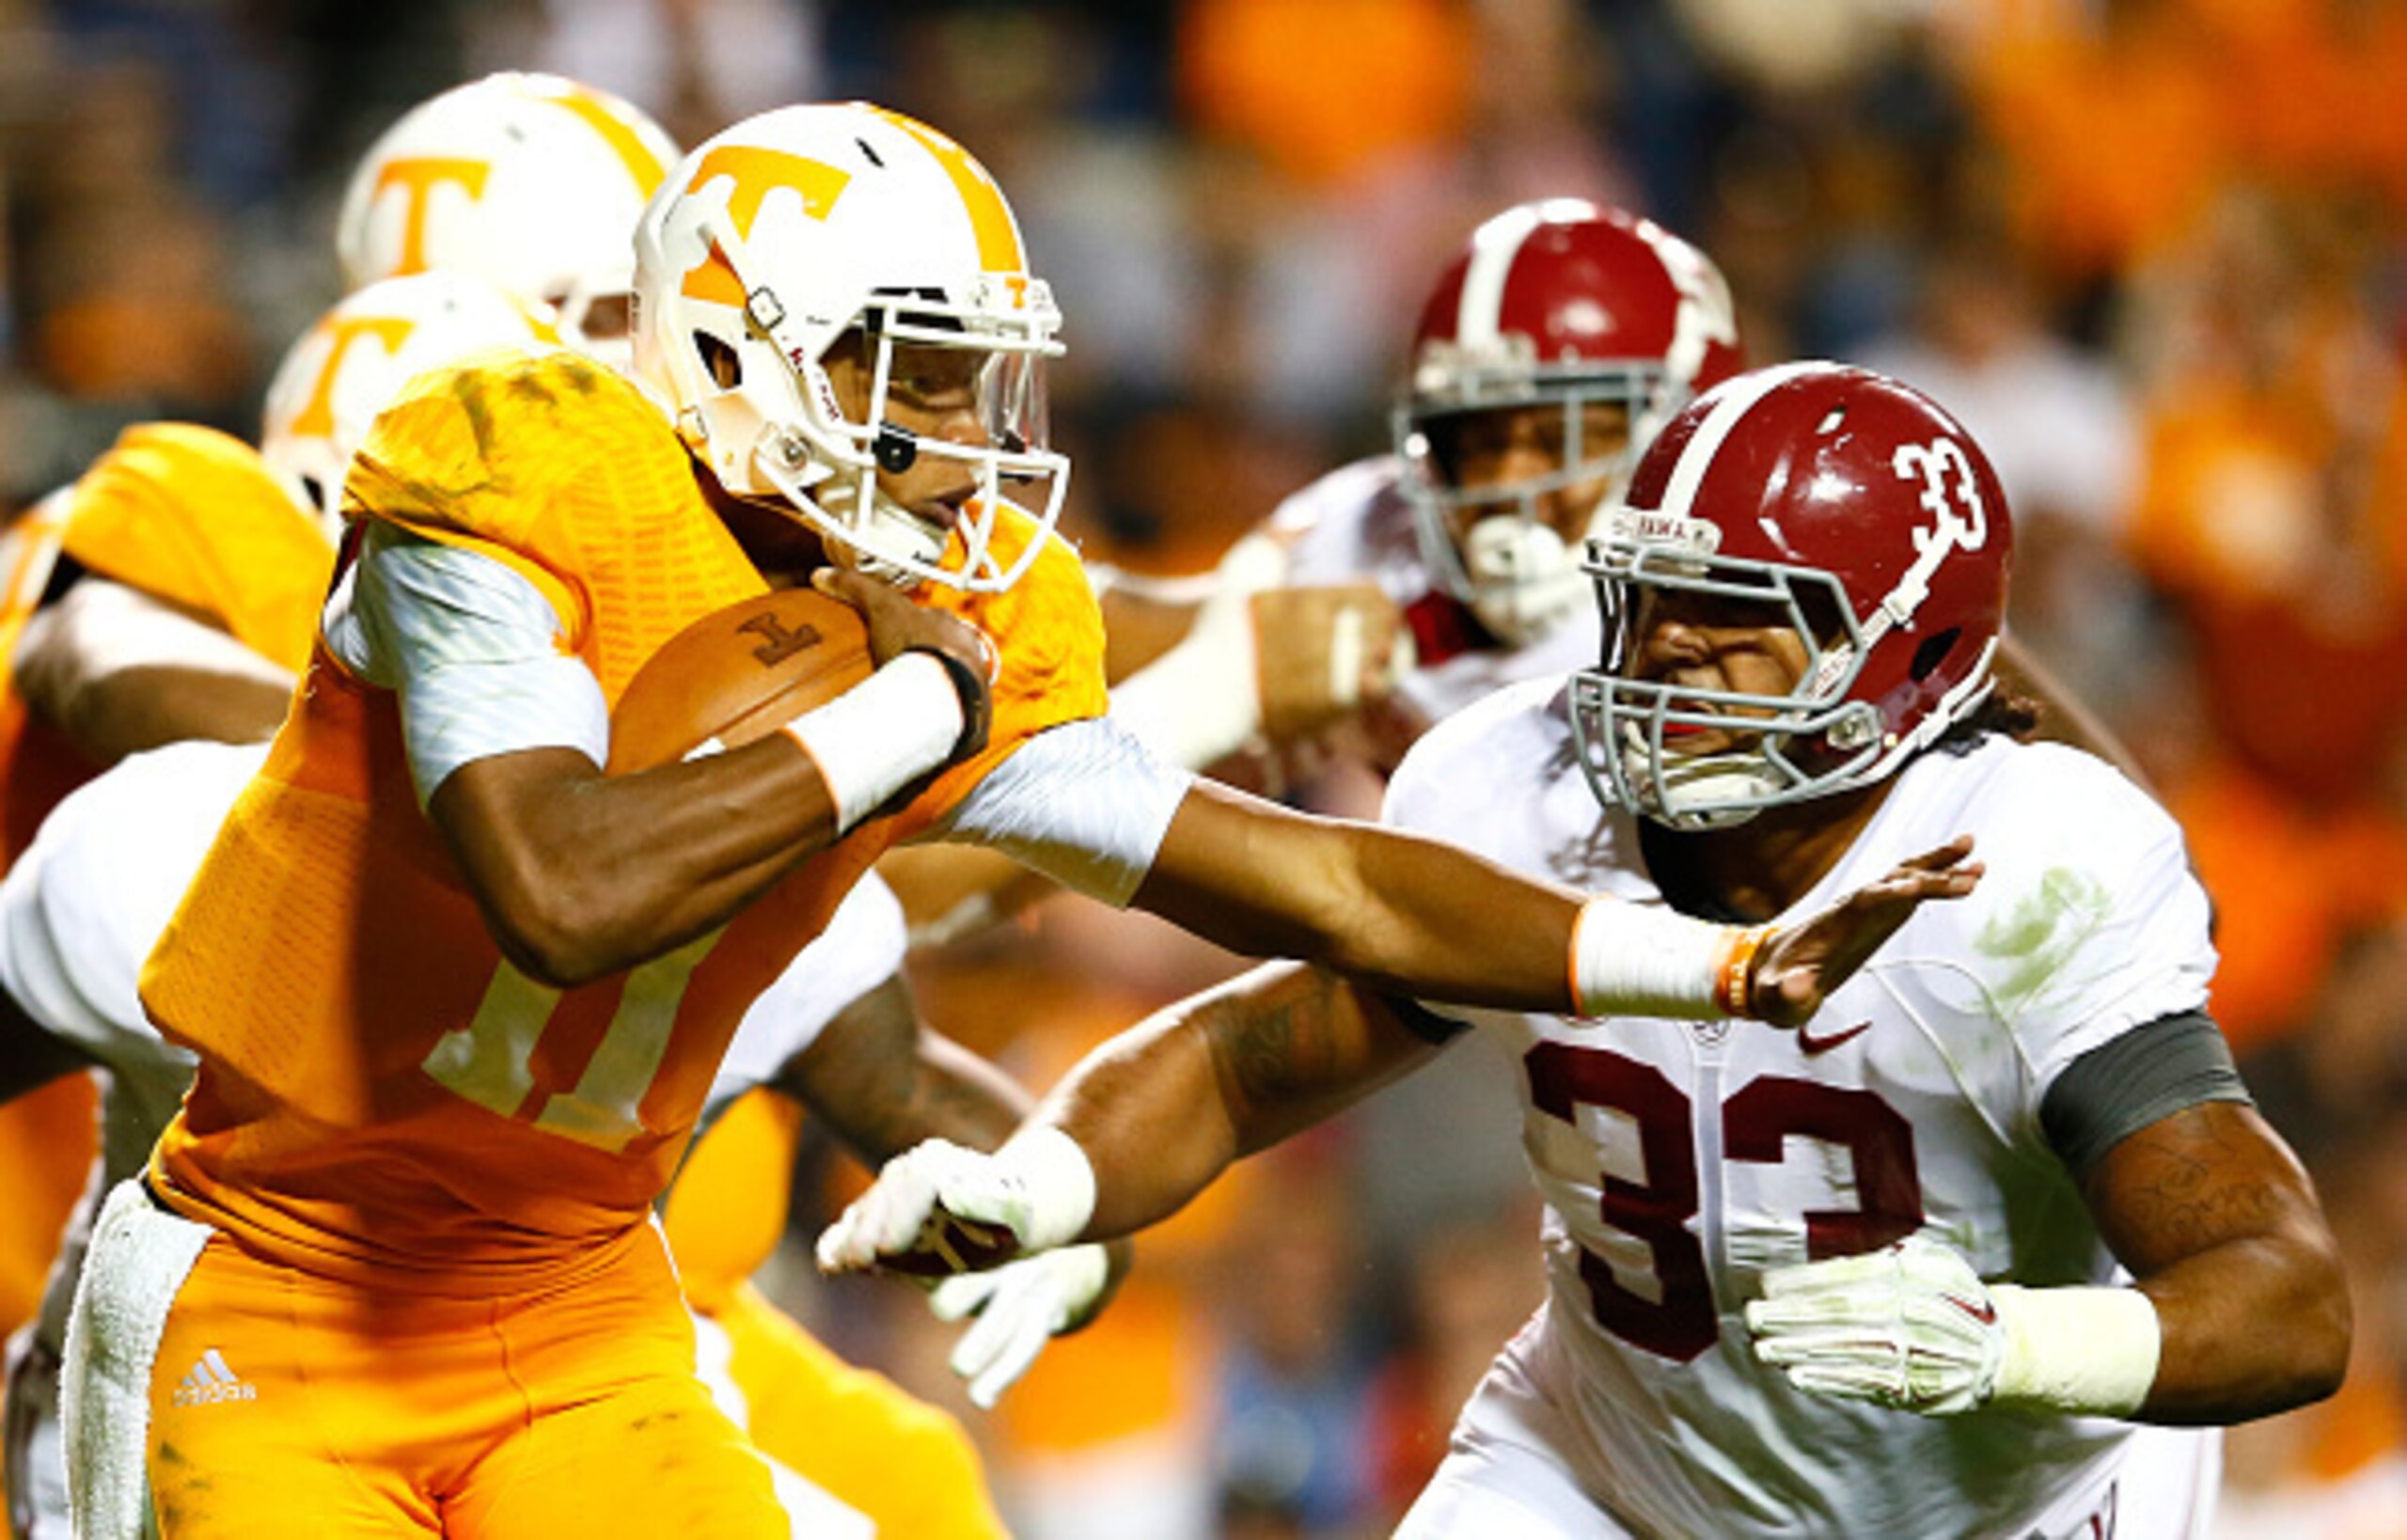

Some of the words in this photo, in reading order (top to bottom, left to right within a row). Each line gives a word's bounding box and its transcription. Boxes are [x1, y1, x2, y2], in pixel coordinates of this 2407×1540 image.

[374, 157, 491, 277] T
[681, 146, 852, 308] T
[1004, 276, 1027, 309] T
[290, 313, 417, 436] T
[1892, 438, 1987, 551] 33
[736, 612, 824, 668] T
[1523, 1040, 1926, 1361] 33
[172, 1379, 257, 1408] adidas
